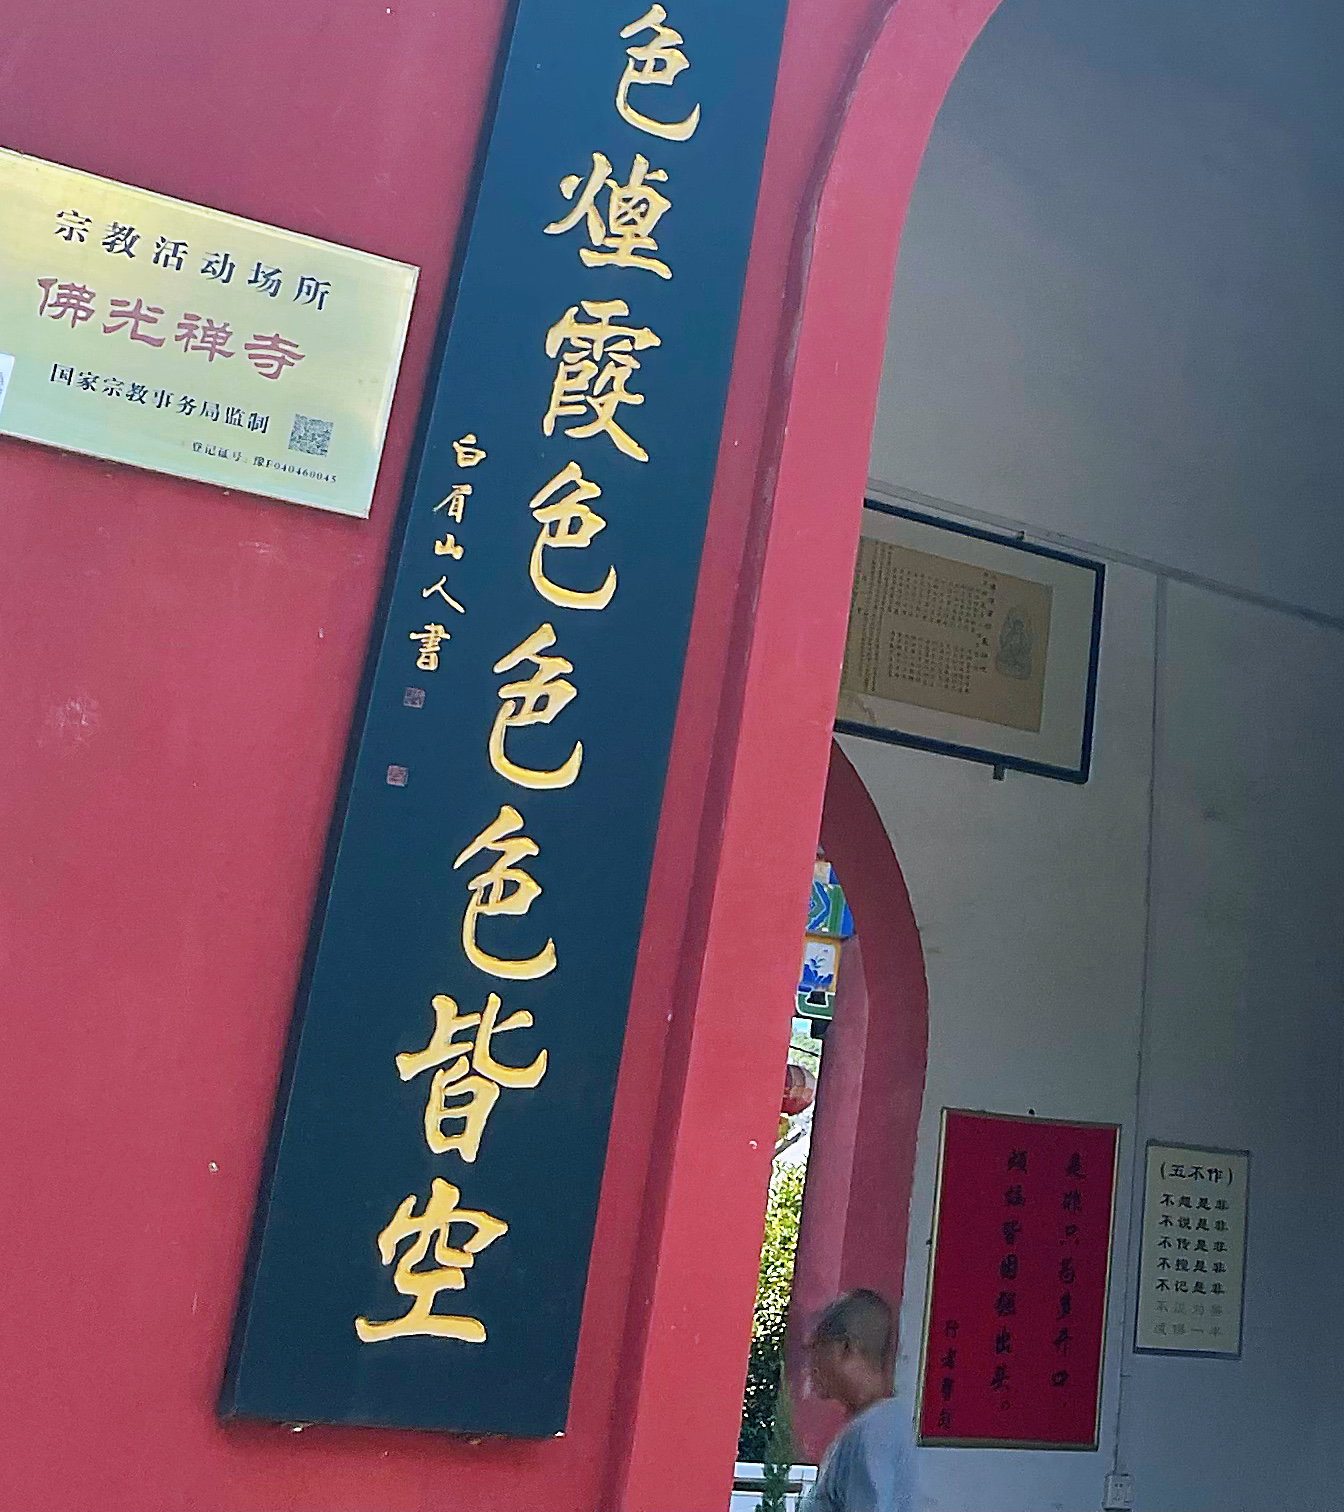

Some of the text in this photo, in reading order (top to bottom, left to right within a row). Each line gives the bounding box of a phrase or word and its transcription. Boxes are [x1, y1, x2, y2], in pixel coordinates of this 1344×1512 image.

[53, 208, 332, 312] 宗教活动场所
[36, 277, 306, 380] 佛光禅寺
[49, 362, 270, 435] 国家宗教事务局监制
